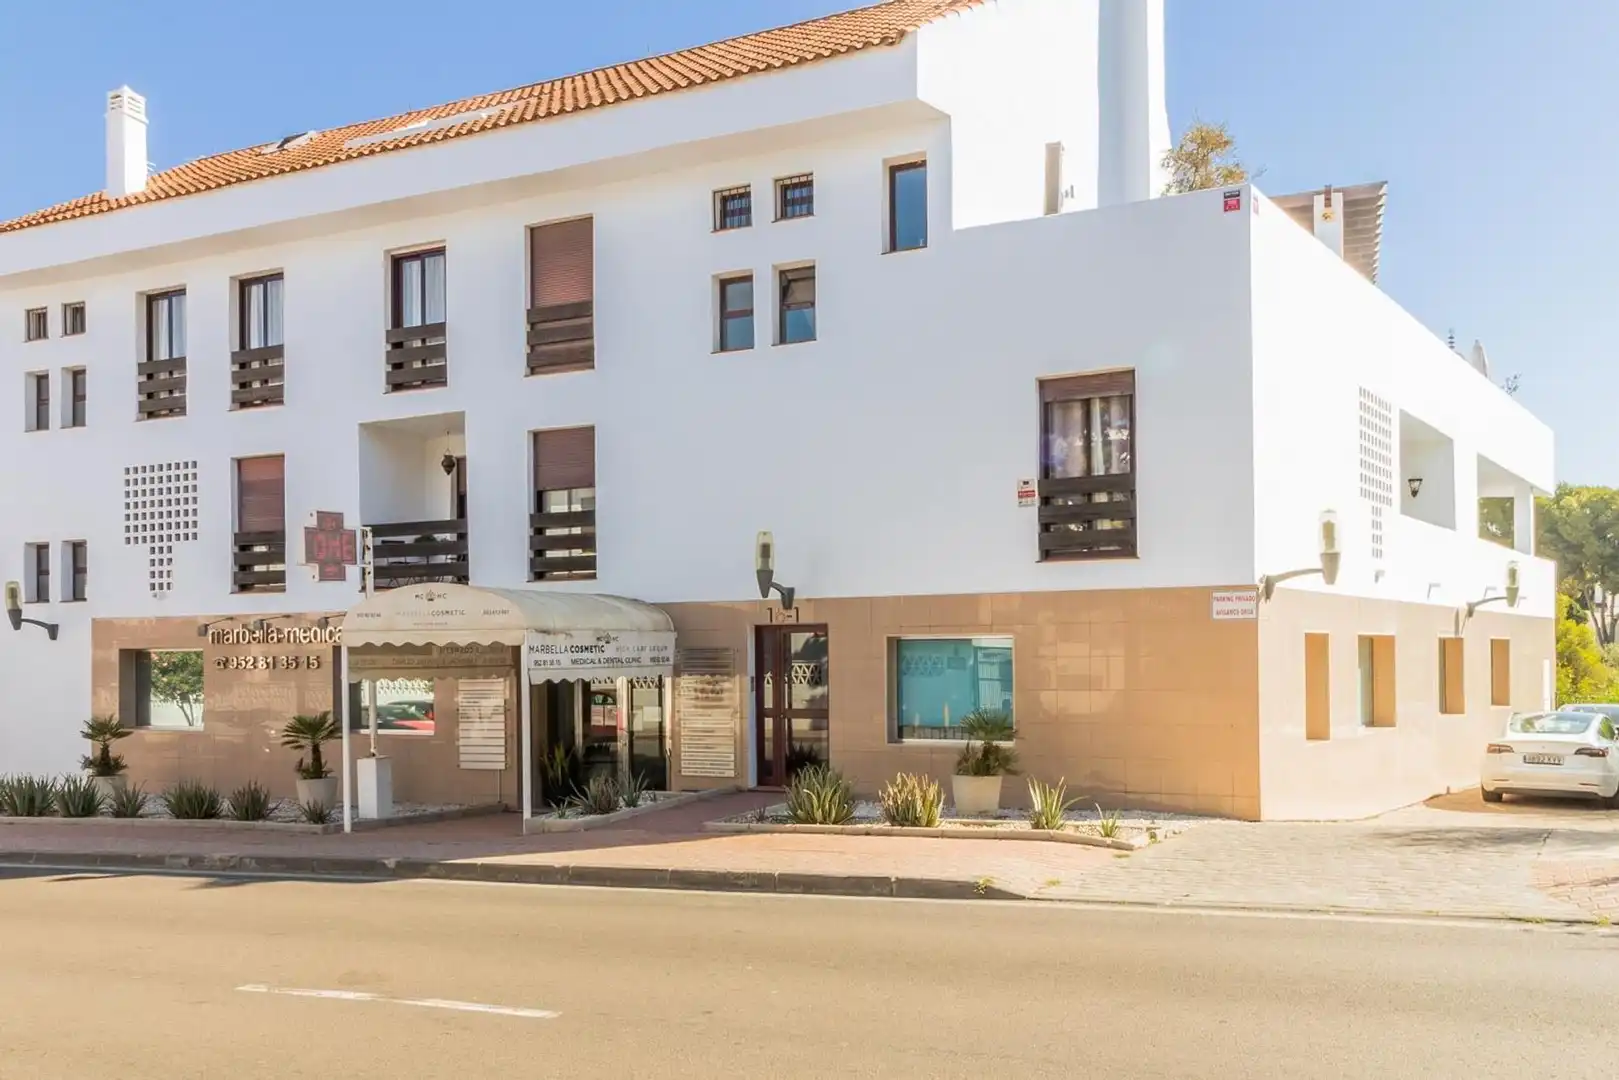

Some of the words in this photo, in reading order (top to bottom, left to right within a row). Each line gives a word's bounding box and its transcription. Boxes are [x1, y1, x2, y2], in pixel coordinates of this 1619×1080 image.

[430, 609, 466, 617] COSMETIC
[528, 645, 569, 654] MARBELLA
[569, 644, 605, 654] COSMETIC
[229, 656, 255, 669] 952
[257, 656, 276, 669] 81
[280, 656, 299, 669] 35
[302, 655, 321, 669] 15
[625, 656, 642, 664] CLINIC
